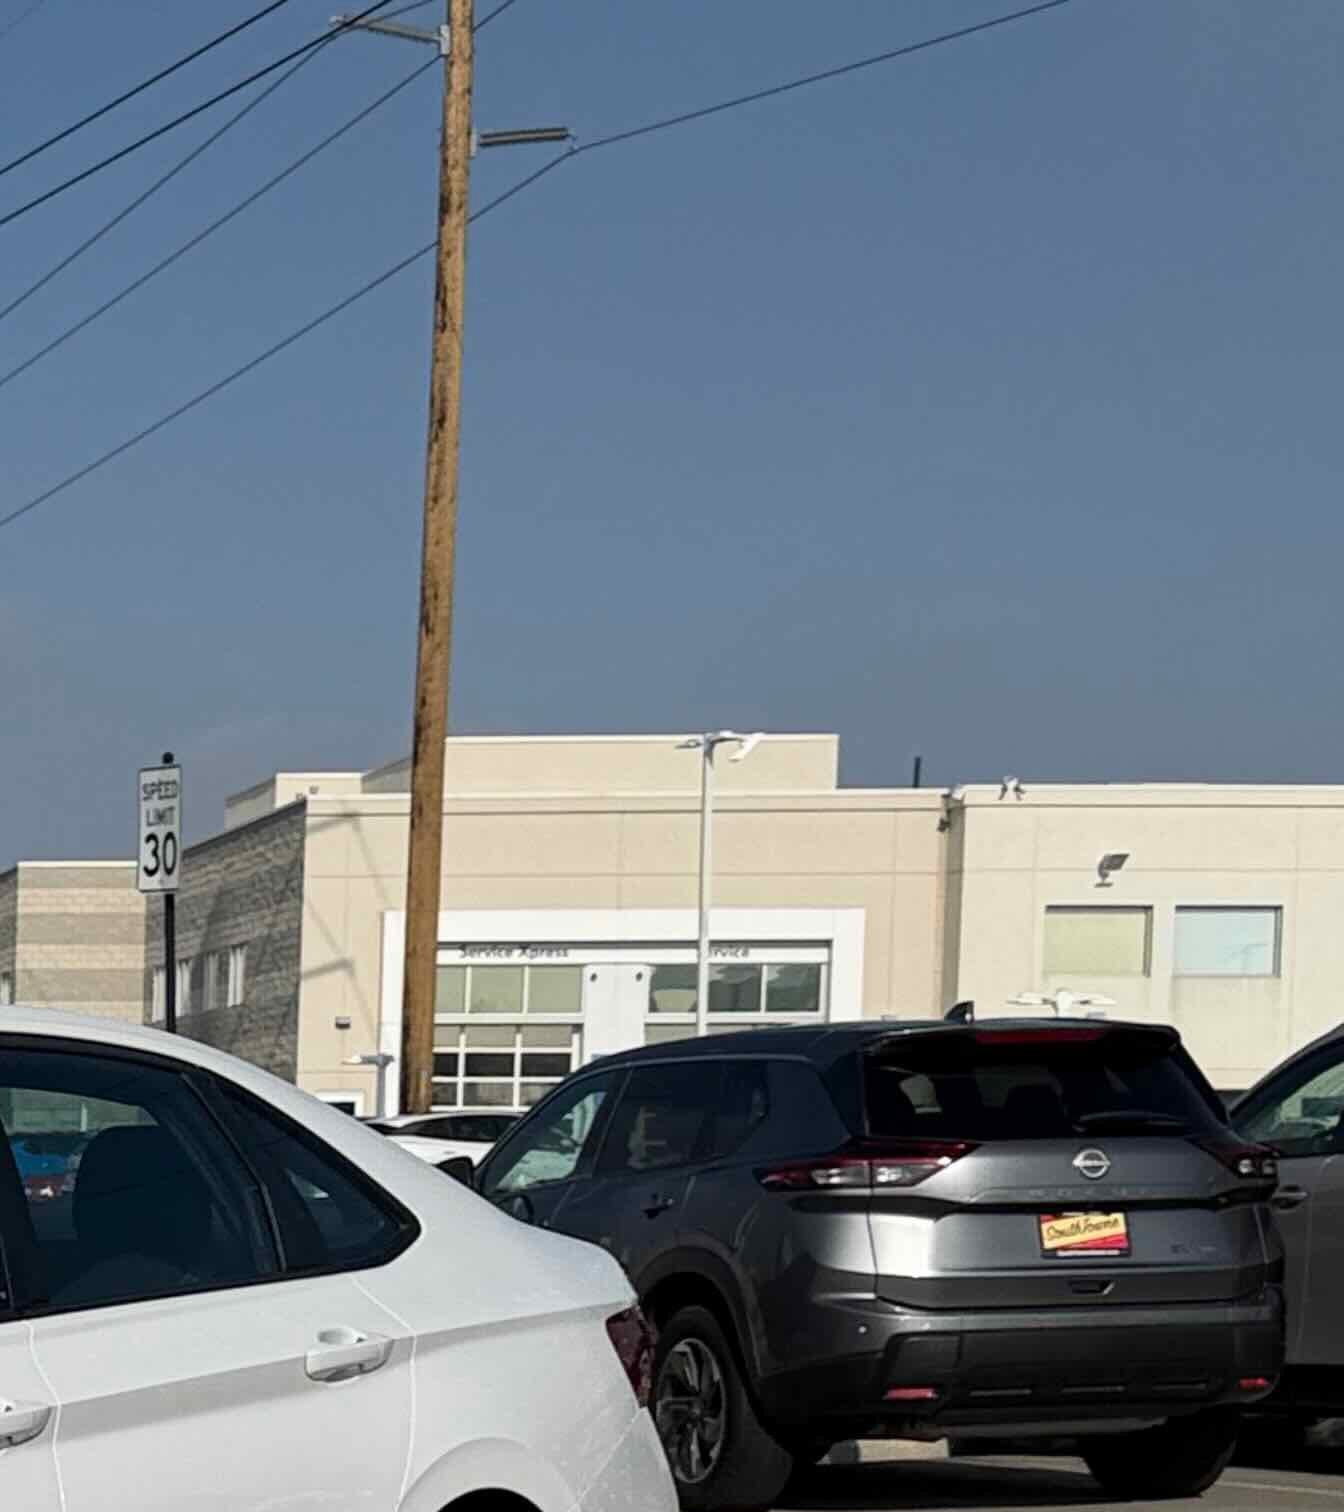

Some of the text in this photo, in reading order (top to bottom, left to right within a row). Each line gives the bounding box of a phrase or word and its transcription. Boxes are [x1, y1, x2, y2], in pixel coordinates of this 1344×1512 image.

[143, 780, 178, 800] SPEED
[146, 806, 175, 826] LIMIT
[143, 831, 177, 877] 30
